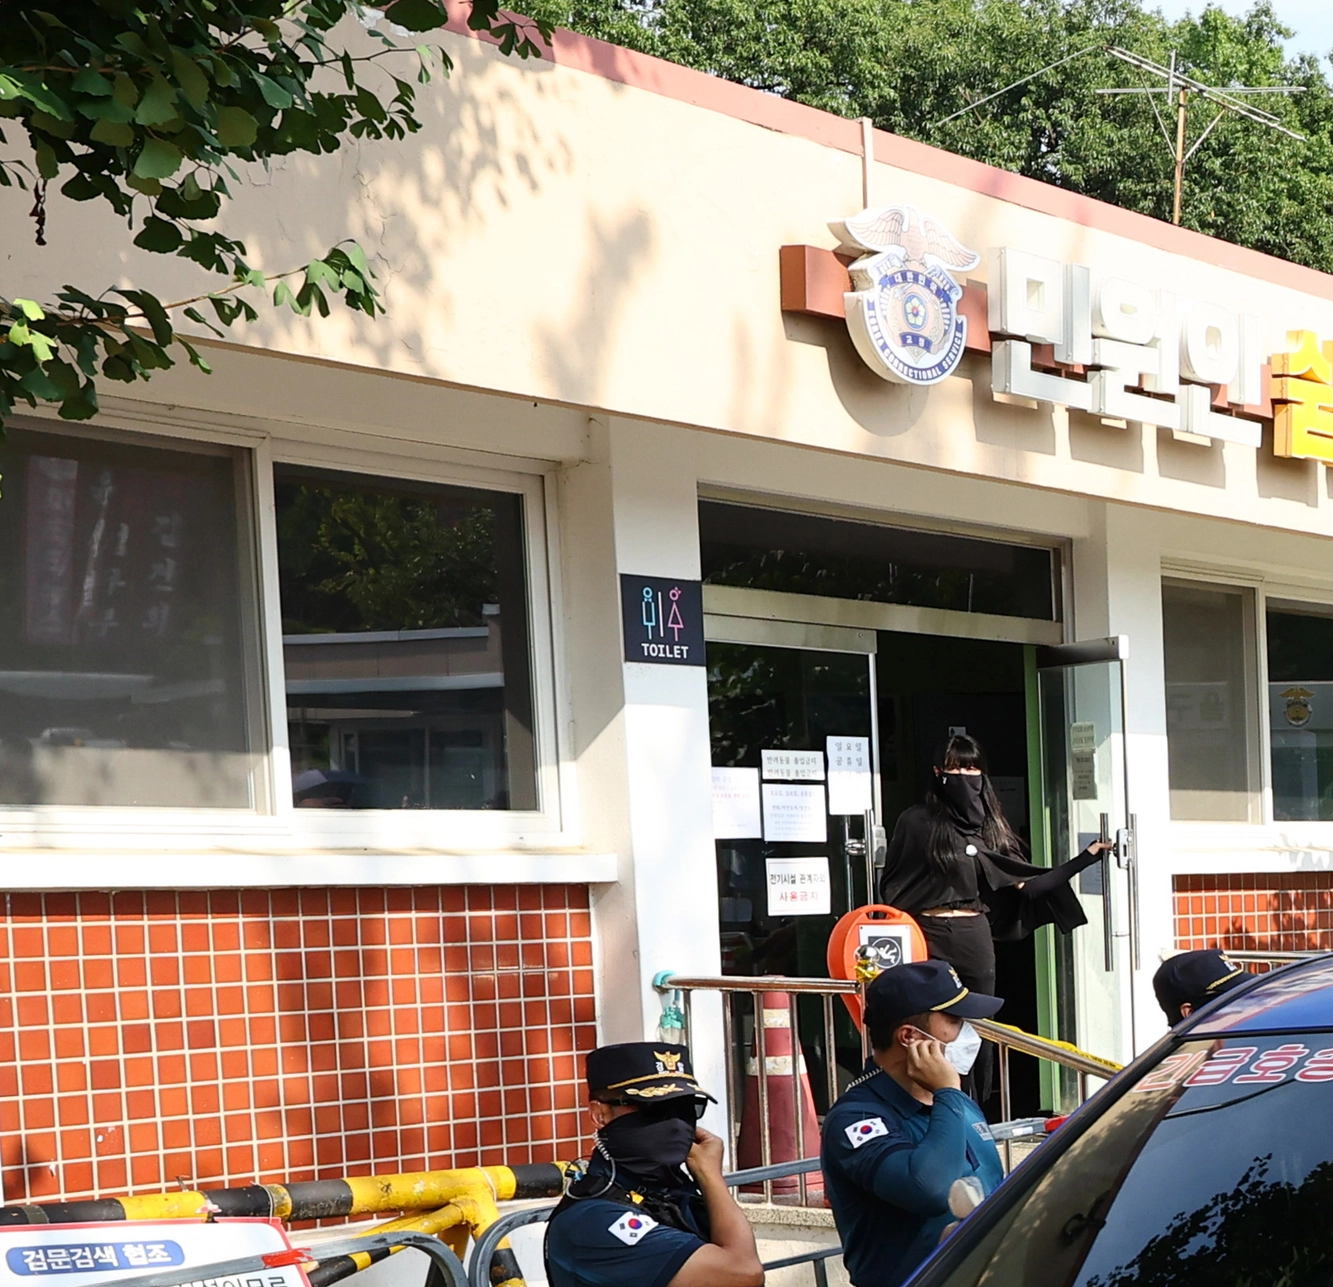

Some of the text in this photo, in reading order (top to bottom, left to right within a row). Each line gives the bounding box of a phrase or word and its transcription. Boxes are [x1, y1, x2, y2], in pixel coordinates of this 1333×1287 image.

[883, 347, 943, 381] CORRECTIONAL
[941, 330, 964, 371] SERVICE
[988, 246, 1263, 448] 민원인
[641, 642, 689, 660] TOILET
[770, 873, 796, 885] 전기시설
[779, 891, 819, 902] 사용금지
[22, 1242, 173, 1273] 검문검색 협조
